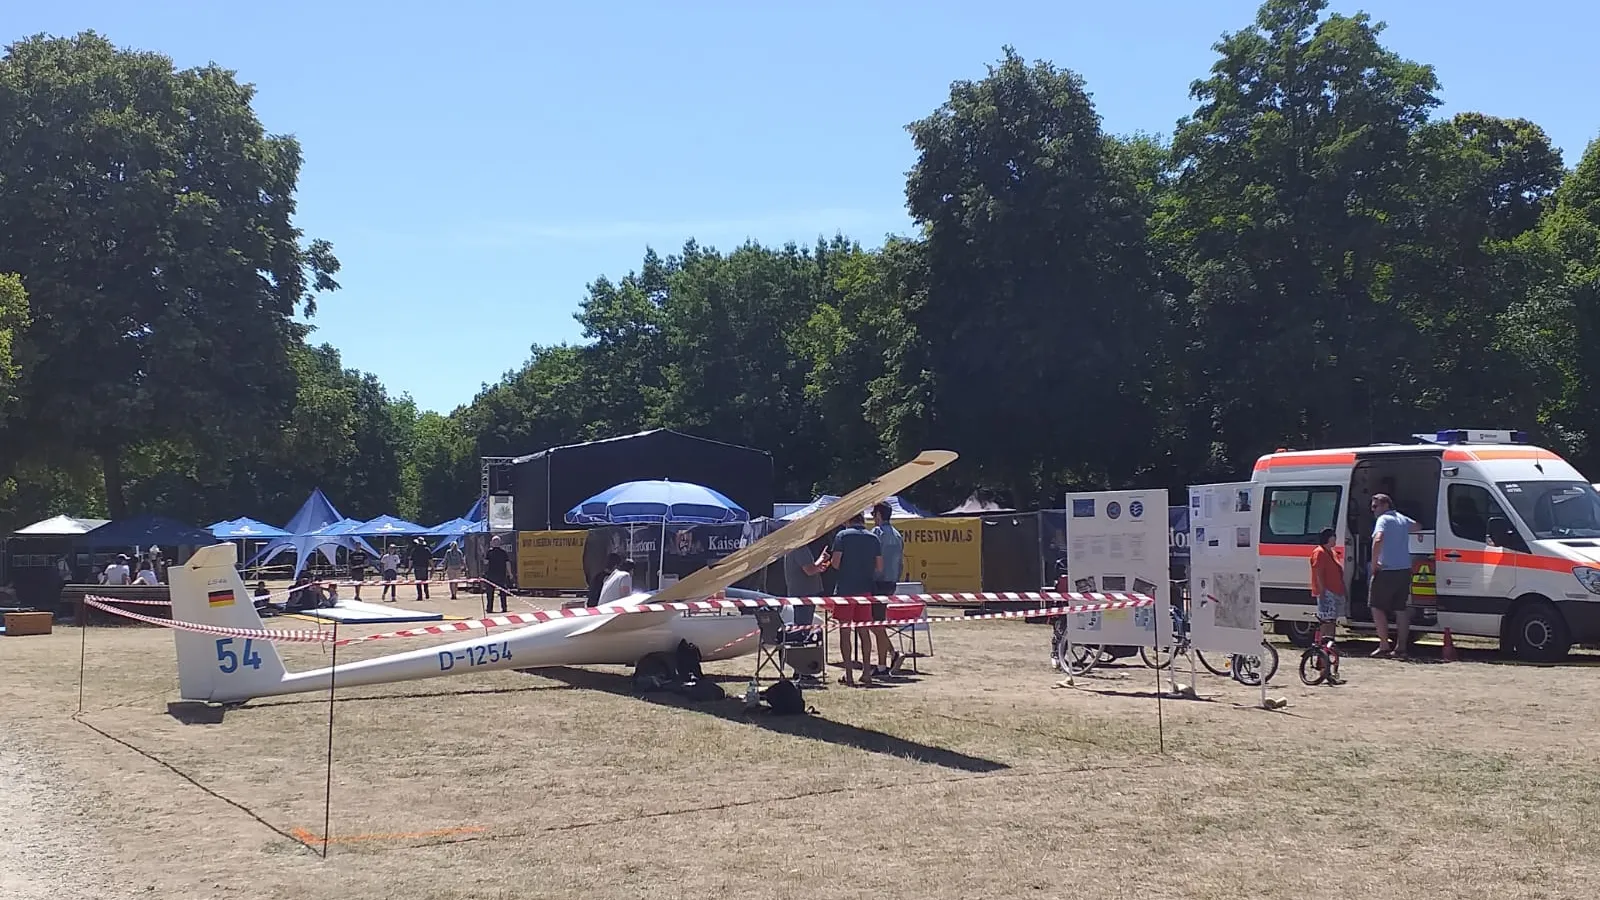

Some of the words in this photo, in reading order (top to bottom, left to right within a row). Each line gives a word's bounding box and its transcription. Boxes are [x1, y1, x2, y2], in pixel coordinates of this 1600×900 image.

[915, 529, 973, 543] FESTIVALS
[215, 637, 262, 674] 54
[438, 641, 513, 671] D-1254
